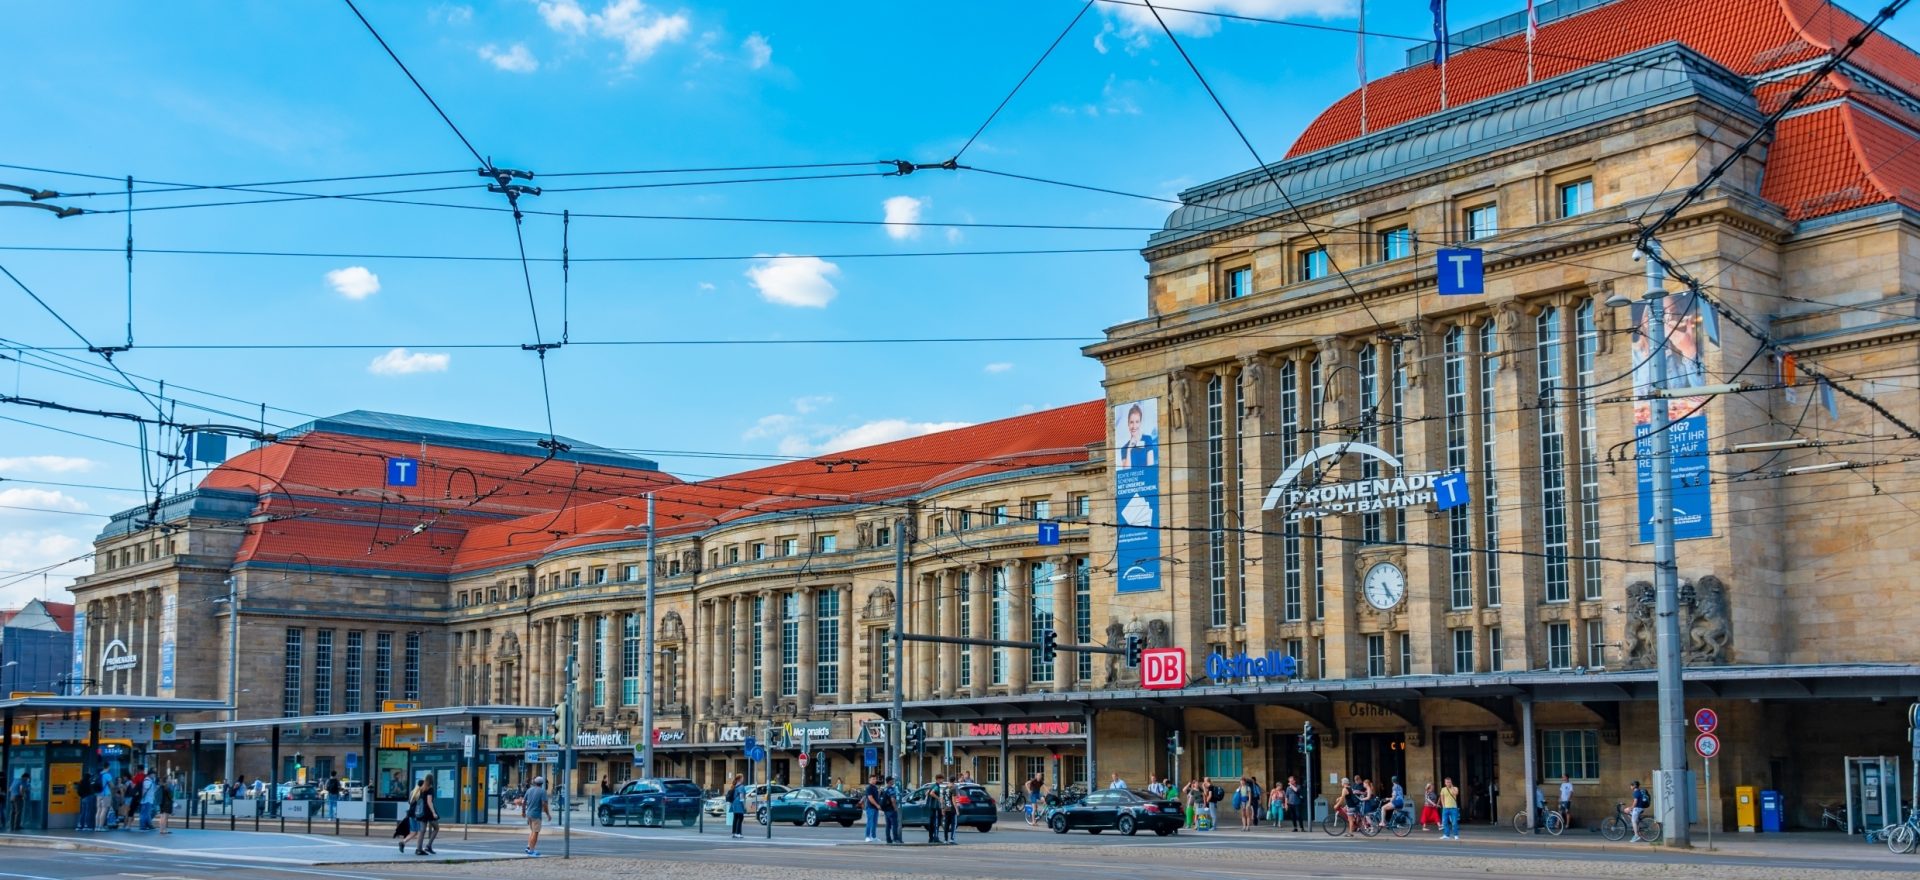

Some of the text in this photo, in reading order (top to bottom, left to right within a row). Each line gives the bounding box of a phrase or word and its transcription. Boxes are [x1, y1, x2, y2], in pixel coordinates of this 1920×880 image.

[1448, 255, 1472, 288] T
[1638, 438, 1652, 447] HIE
[1688, 430, 1705, 440] IHR
[1680, 441, 1699, 452] AUF
[395, 462, 411, 482] T
[1290, 469, 1461, 504] PROMENADE
[1441, 477, 1459, 503] T
[1291, 491, 1438, 520] HAUPTBAHNH
[1043, 526, 1054, 542] T
[1147, 655, 1179, 682] DB
[1205, 650, 1297, 679] Osthalle
[720, 726, 748, 741] KFC
[793, 727, 830, 737] Mconald's
